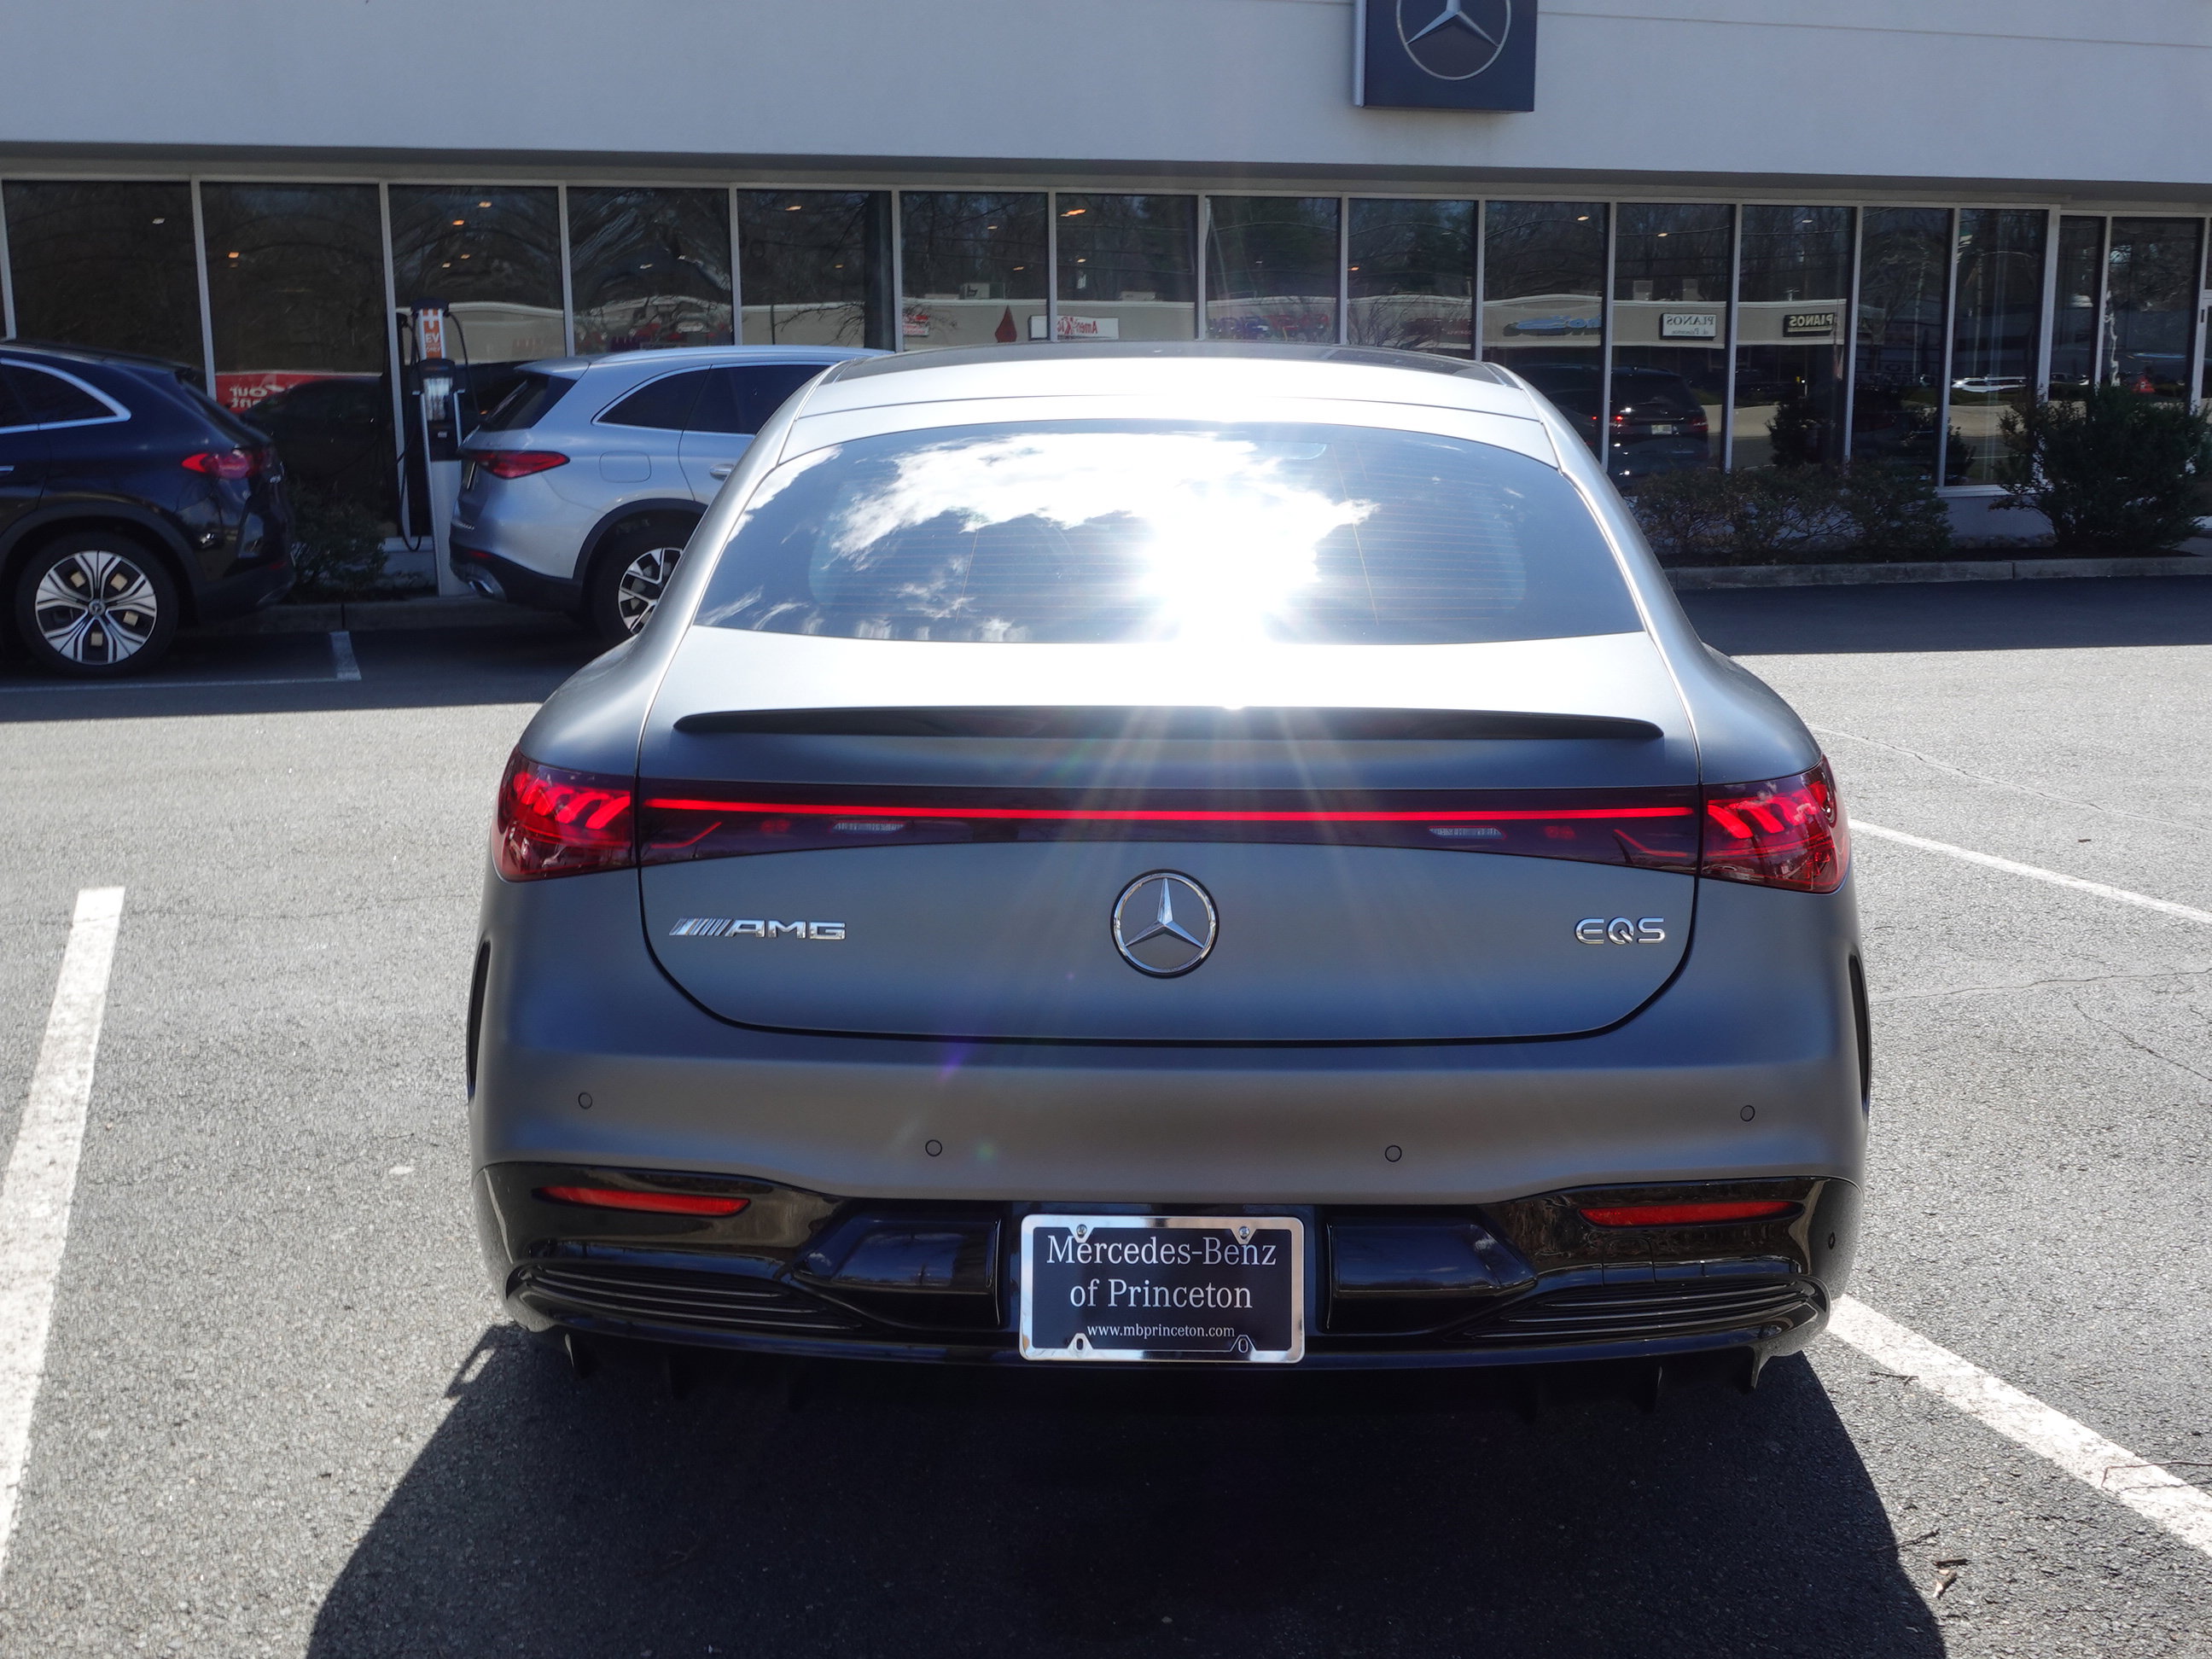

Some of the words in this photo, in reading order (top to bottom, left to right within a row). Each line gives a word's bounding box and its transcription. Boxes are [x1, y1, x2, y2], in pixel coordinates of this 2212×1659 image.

[426, 333, 439, 343] EV
[725, 919, 846, 940] AMG
[1575, 917, 1666, 945] EQS
[1046, 1235, 1277, 1266] Mercedes-Benz
[1069, 1278, 1100, 1307] of
[1108, 1278, 1253, 1308] Princeton
[1086, 1324, 1235, 1339] www.mbprinceton.com
